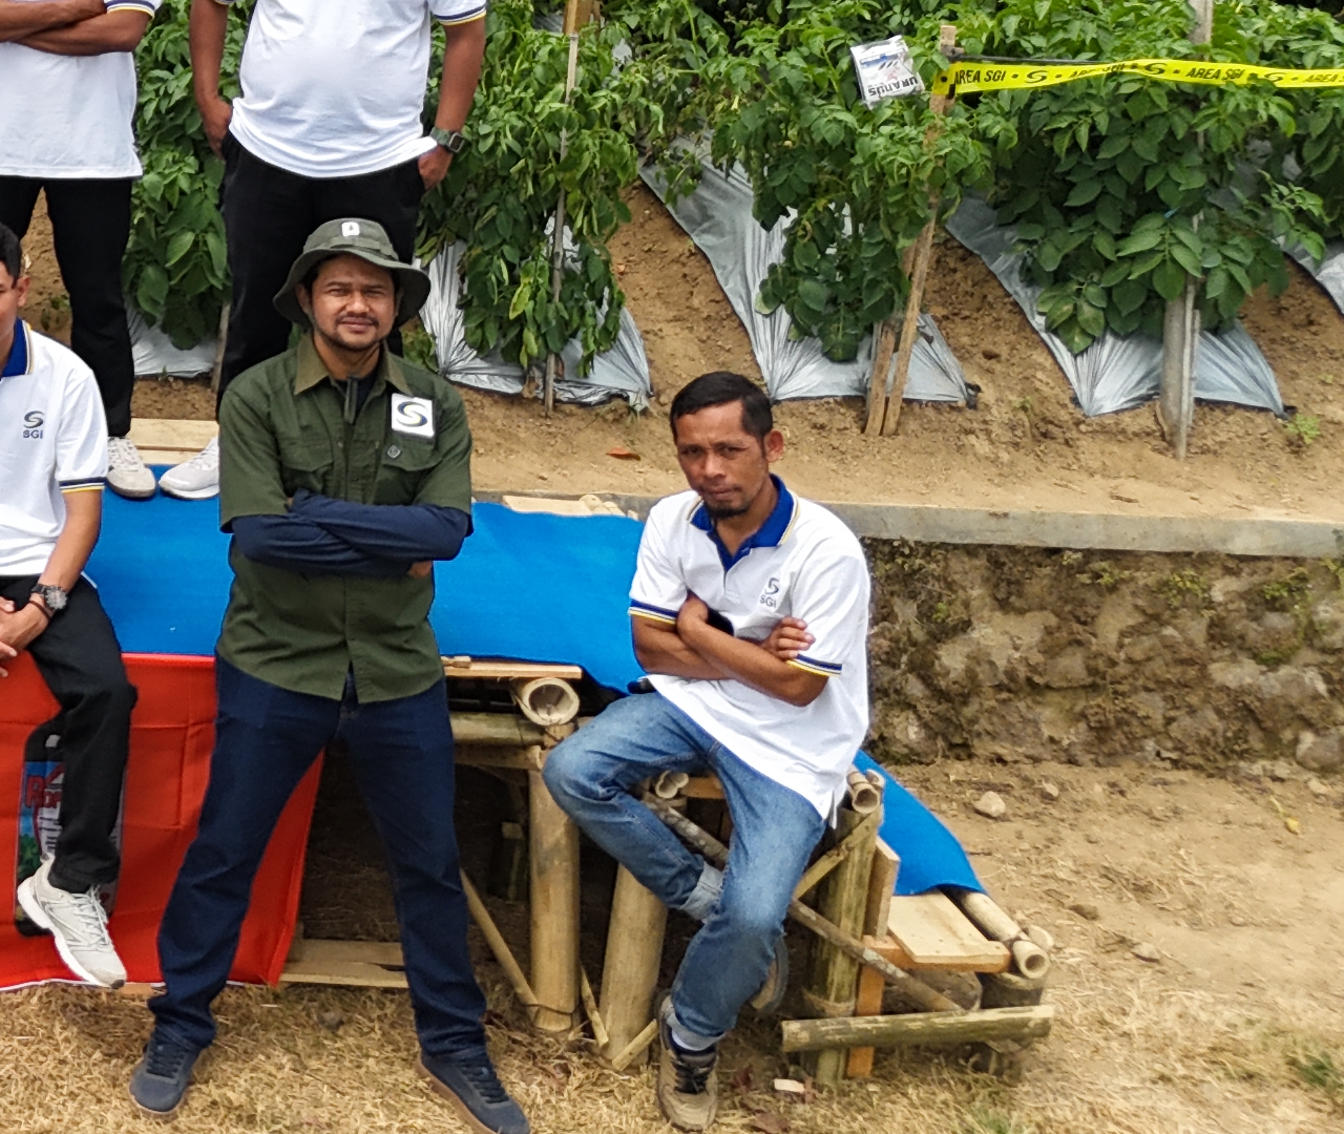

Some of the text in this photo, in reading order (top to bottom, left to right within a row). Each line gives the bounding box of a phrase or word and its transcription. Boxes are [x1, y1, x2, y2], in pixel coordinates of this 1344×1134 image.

[954, 67, 1006, 85] AREA SGI
[1185, 68, 1245, 80] AREA SGI
[1303, 74, 1336, 83] AREA
[868, 77, 919, 97] URANUS
[22, 429, 43, 439] SGI
[760, 594, 777, 608] SGI
